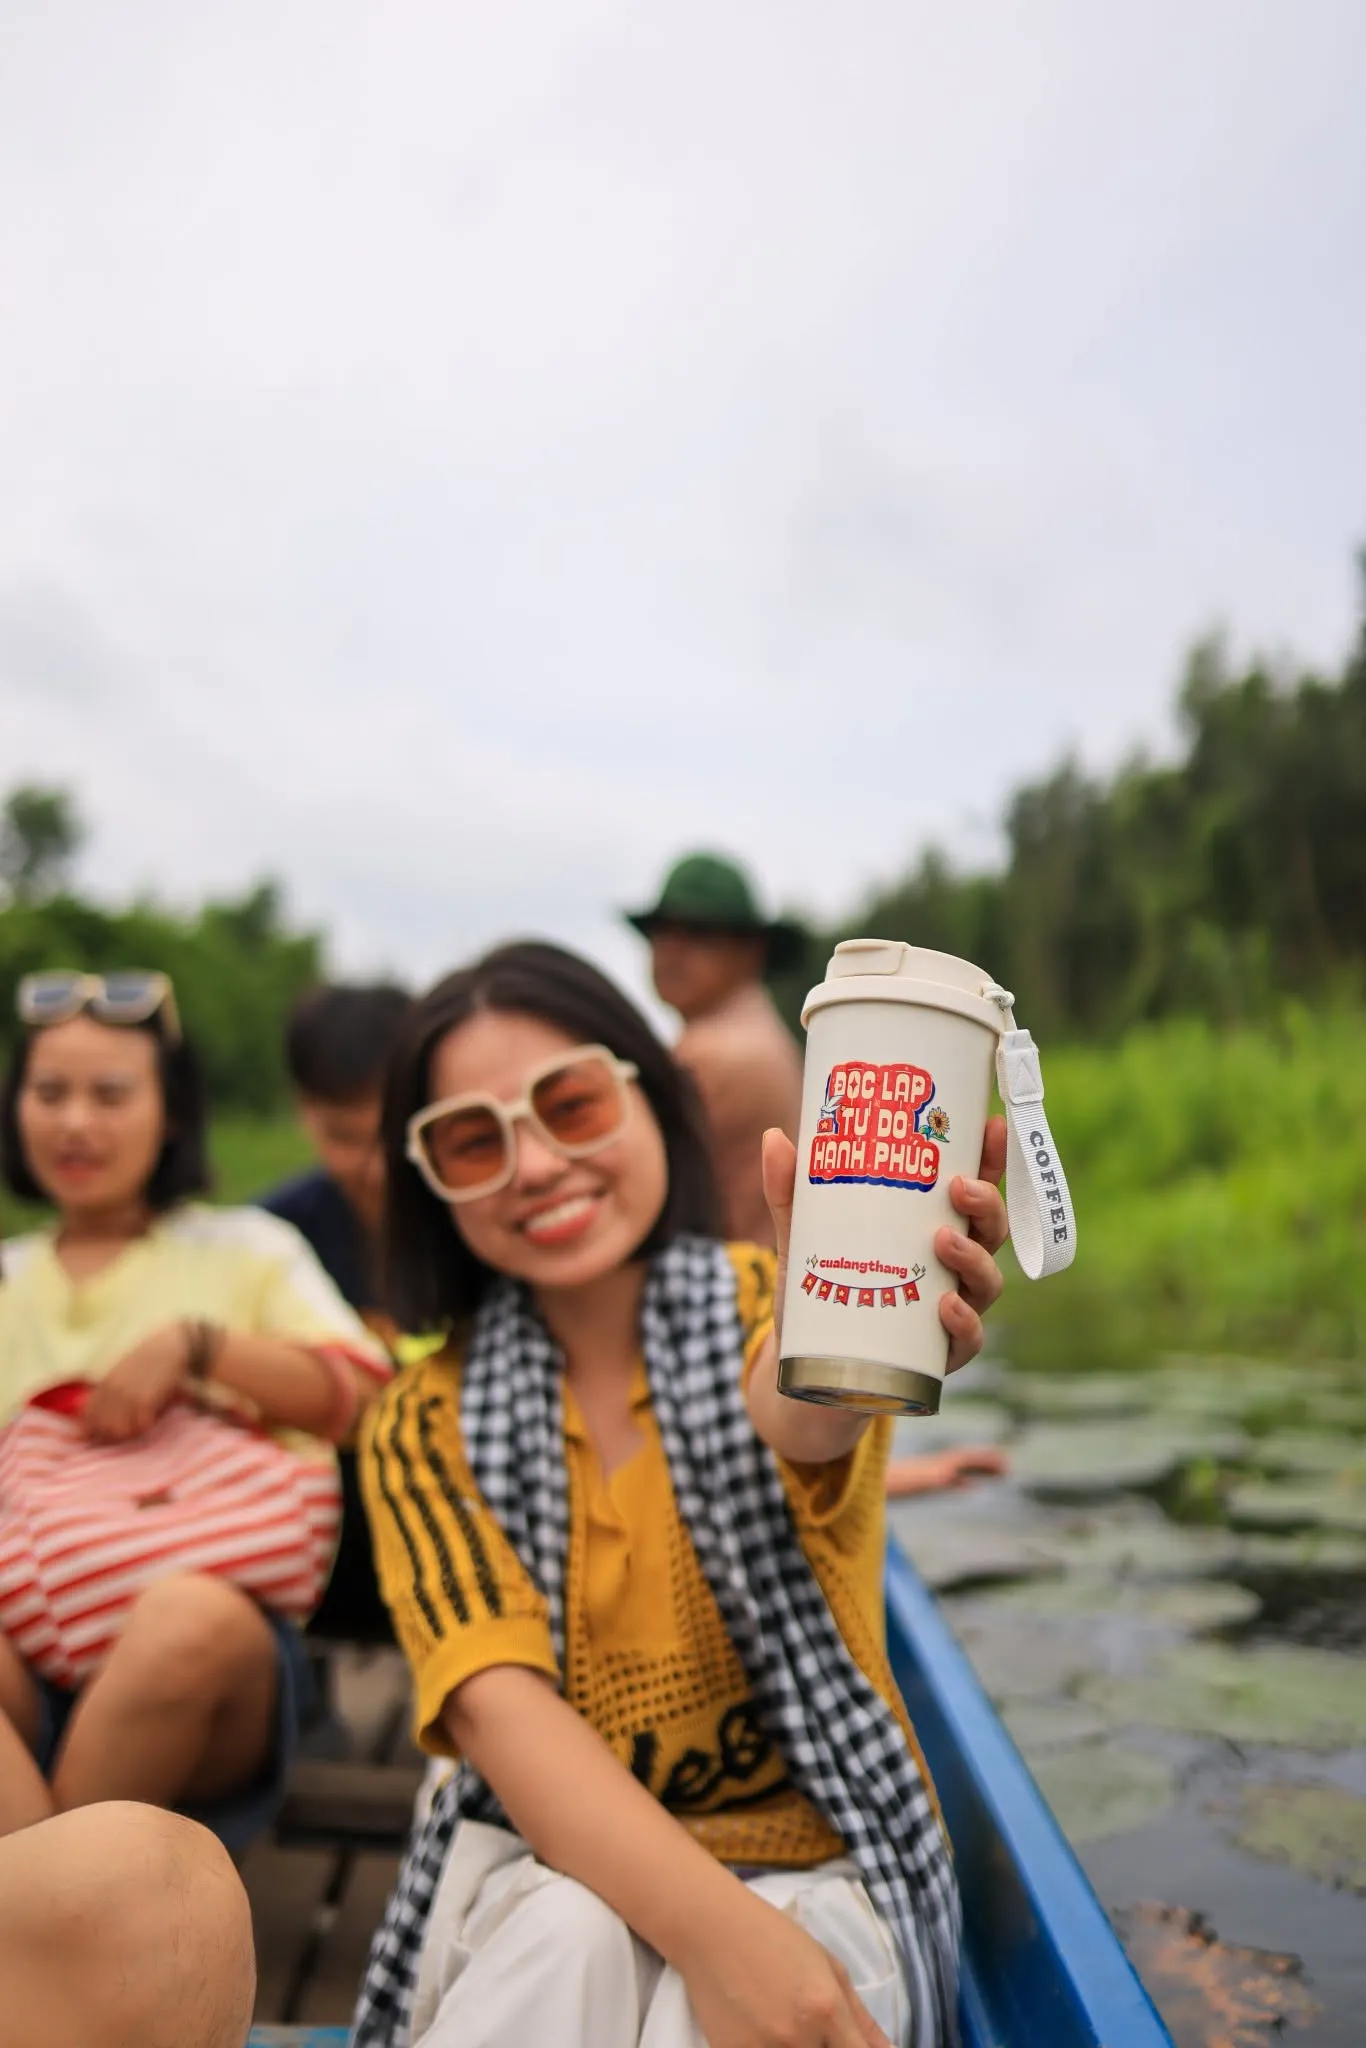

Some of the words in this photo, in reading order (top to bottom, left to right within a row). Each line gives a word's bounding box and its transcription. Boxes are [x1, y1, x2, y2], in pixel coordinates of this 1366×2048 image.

[877, 1109, 908, 1139] DO
[874, 1140, 934, 1177] PHÚC
[1029, 1130, 1068, 1244] COFFEE
[819, 1256, 908, 1279] cualangthang
